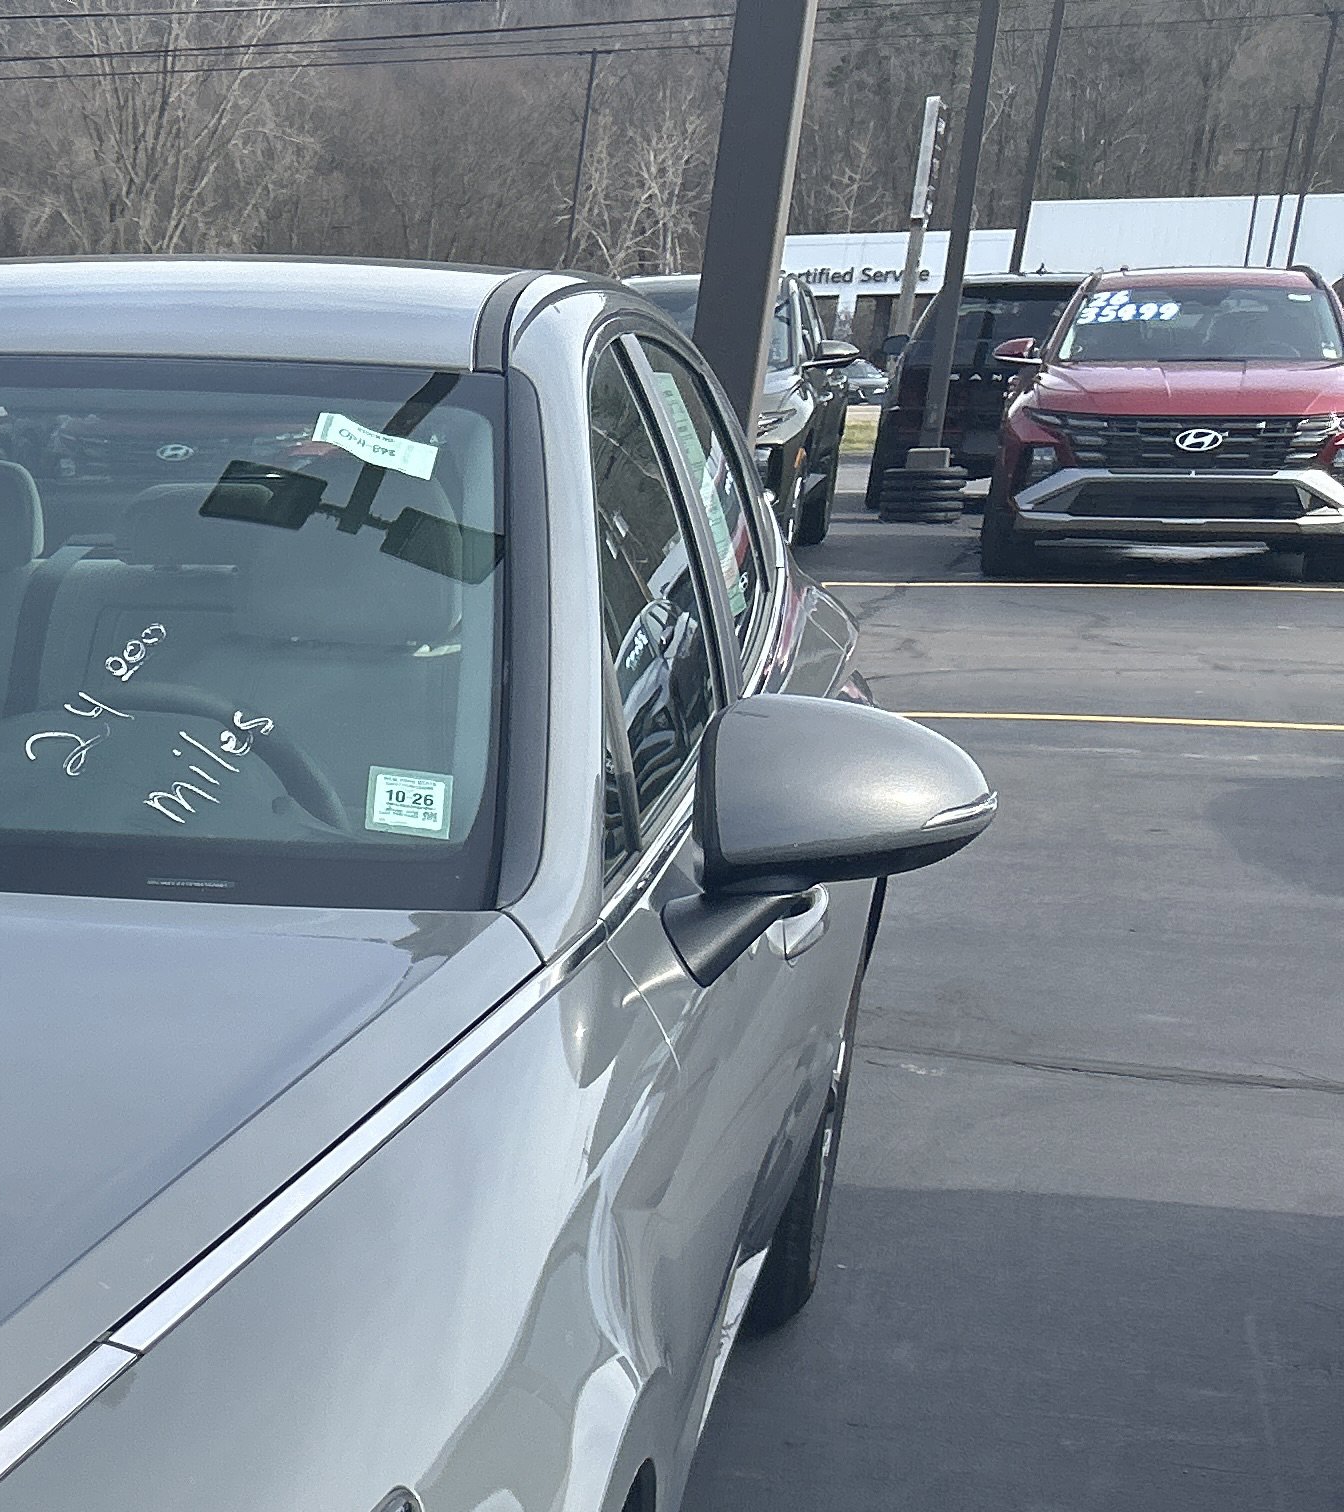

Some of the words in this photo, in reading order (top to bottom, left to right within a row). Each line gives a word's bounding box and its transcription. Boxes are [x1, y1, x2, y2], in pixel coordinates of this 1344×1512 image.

[860, 267, 930, 283] Serve
[1089, 290, 1130, 308] 26
[949, 373, 1003, 381] SAN
[385, 789, 406, 803] 10
[412, 793, 434, 806] 26
